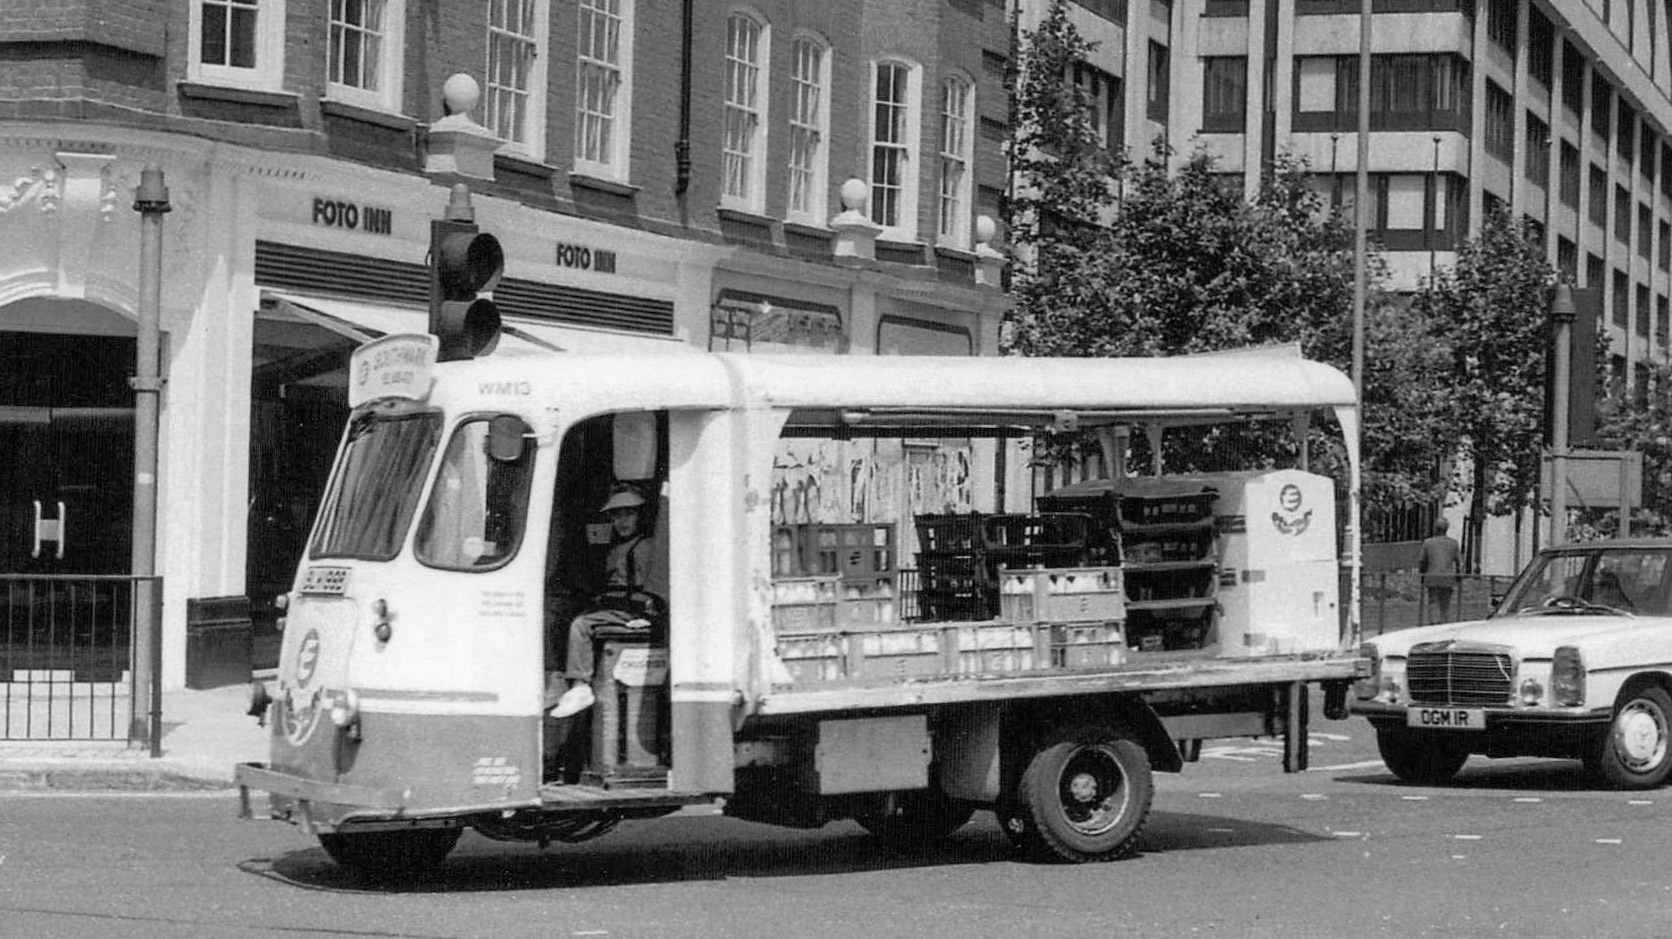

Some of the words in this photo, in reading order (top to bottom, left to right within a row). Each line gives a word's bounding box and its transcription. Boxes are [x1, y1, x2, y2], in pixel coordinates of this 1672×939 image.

[312, 197, 359, 229] FOTO
[362, 206, 393, 236] INN
[556, 243, 591, 271] FOTO
[593, 250, 617, 274] INN
